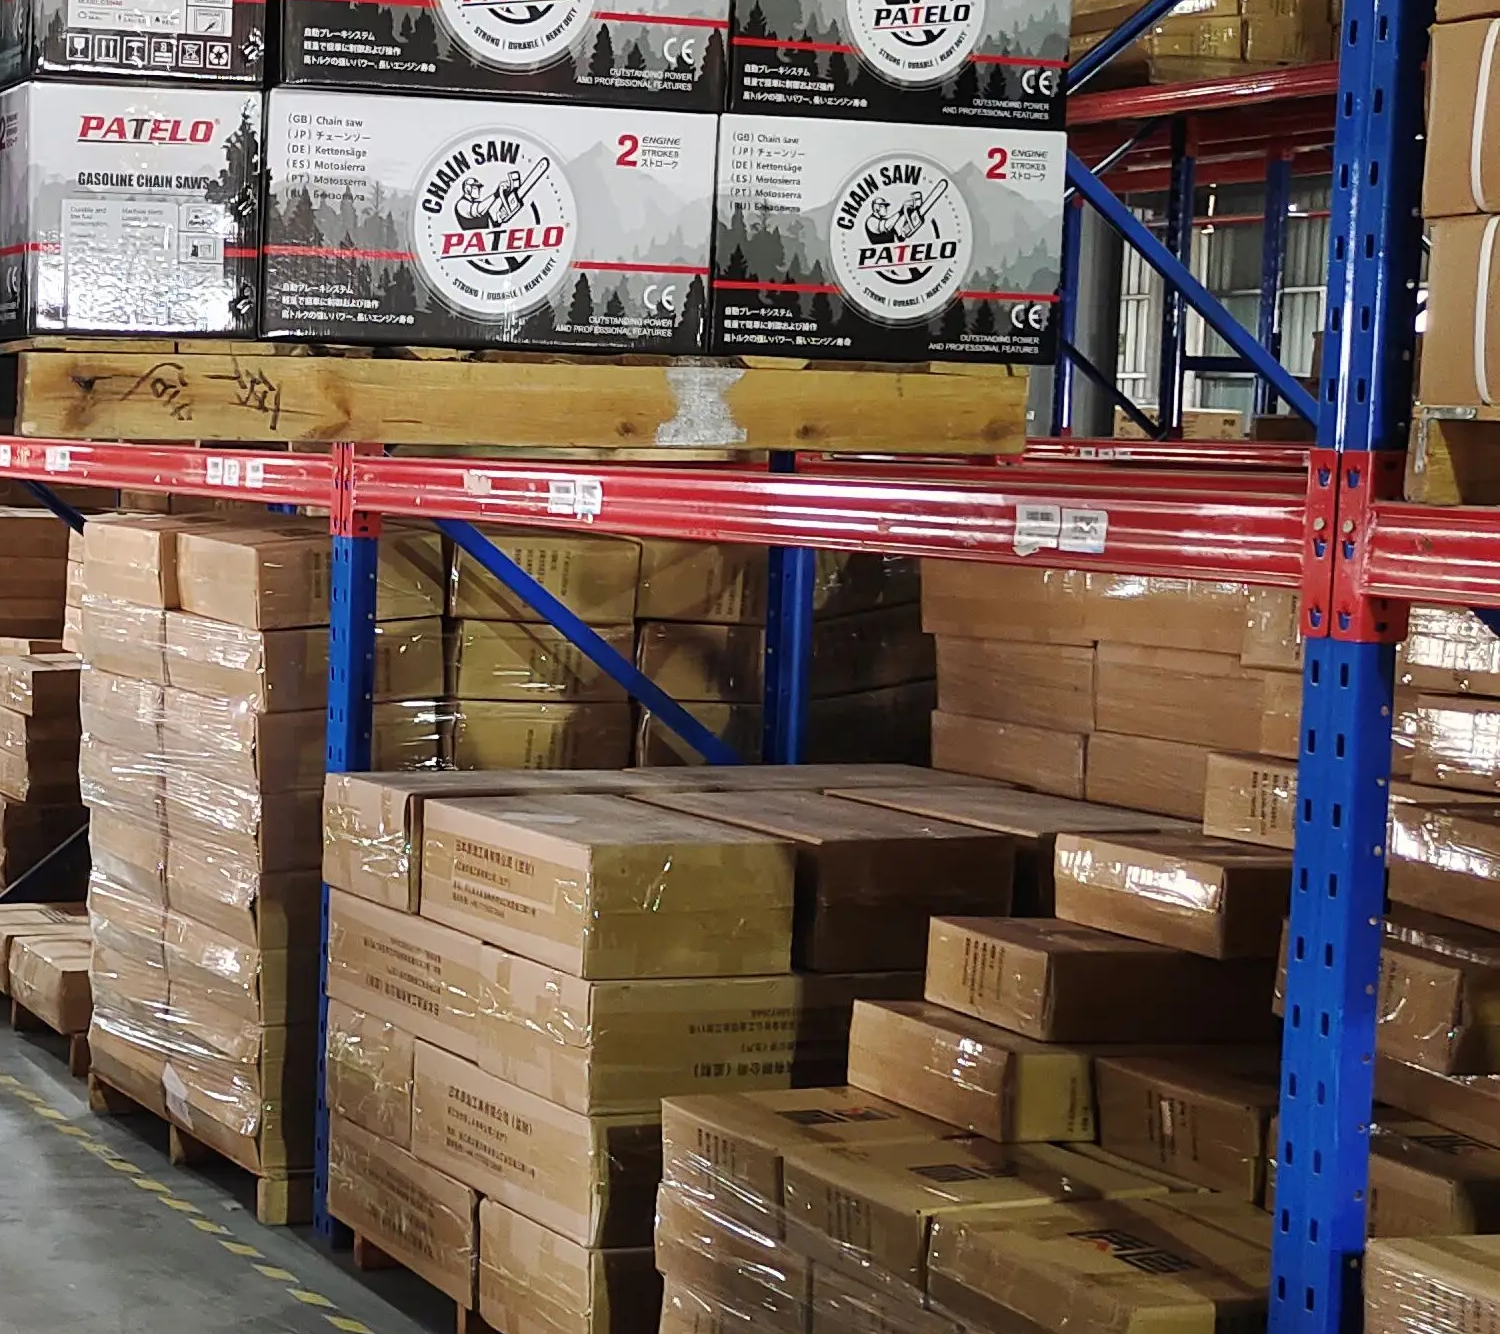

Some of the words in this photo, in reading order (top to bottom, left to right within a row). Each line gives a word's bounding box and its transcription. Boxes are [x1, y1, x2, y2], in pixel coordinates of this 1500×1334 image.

[874, 4, 971, 25] PATELO
[663, 36, 696, 64] CE
[576, 75, 593, 84] AND
[594, 76, 653, 88] PROFESSIONAL
[653, 81, 693, 91] FEATURES
[609, 68, 664, 78] OUTSTANDING
[664, 72, 693, 80] POWER
[1022, 69, 1053, 95] CE
[78, 115, 215, 143] PATELO
[315, 114, 343, 125] Chain
[316, 130, 372, 142] チェーンソー
[616, 133, 640, 167] 2
[642, 136, 680, 146] ENGINE
[313, 159, 366, 171] Motosierra
[640, 159, 678, 169] ストローク
[986, 147, 1008, 179] 2
[78, 172, 134, 188] GASOLINE
[136, 174, 173, 189] CHAIN
[175, 176, 210, 190] SAWS
[421, 150, 471, 214] CHAIN
[471, 140, 521, 164] SAW
[1010, 171, 1046, 181] ストローク
[837, 174, 879, 230] CHAIN
[880, 164, 922, 185] SAW
[441, 226, 565, 254] PATELO
[858, 241, 957, 265] PATELO
[642, 284, 675, 311] CE
[643, 318, 672, 326] POWER
[1010, 303, 1042, 328] CE
[555, 324, 572, 332] AND
[573, 324, 632, 334] PROFESSIONAL
[632, 327, 672, 336] FEATURES
